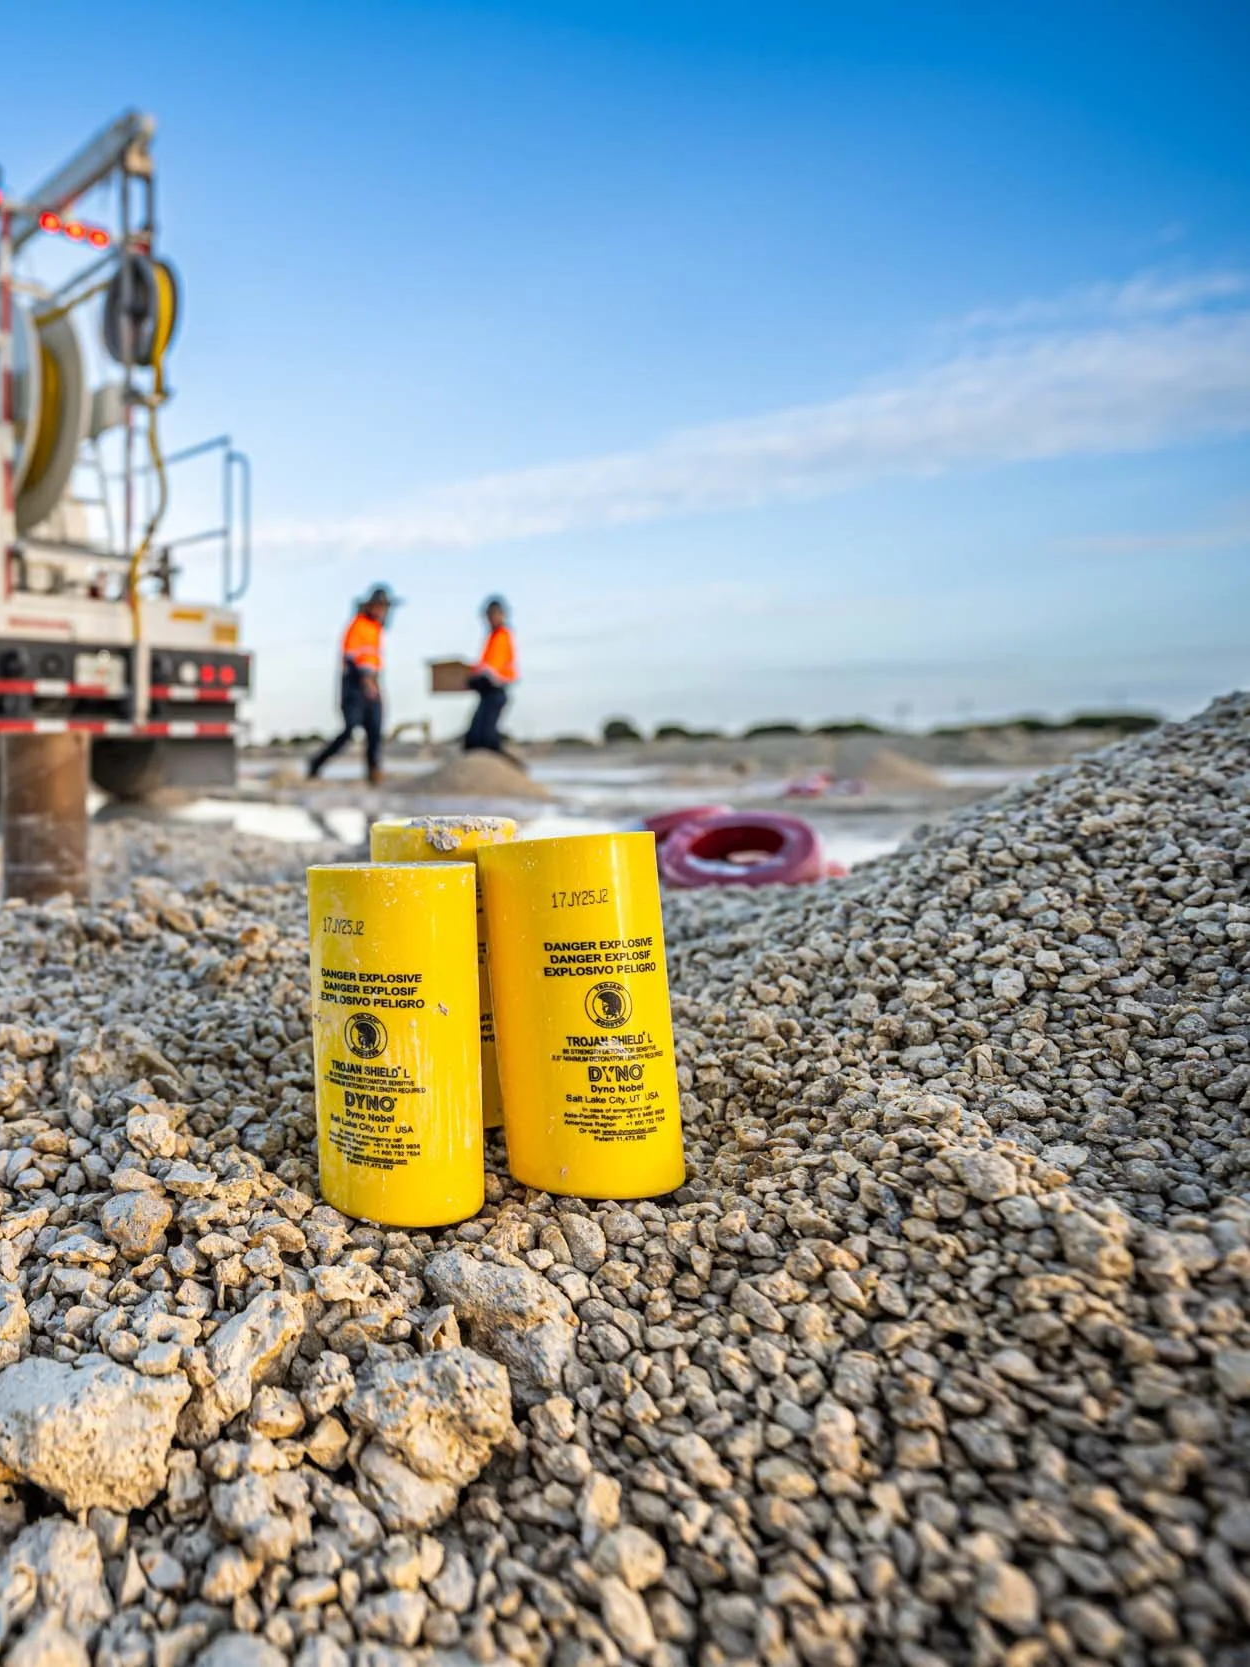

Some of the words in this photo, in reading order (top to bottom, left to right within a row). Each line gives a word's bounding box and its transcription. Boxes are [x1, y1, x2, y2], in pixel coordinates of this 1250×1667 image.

[552, 889, 608, 908] 17JY25J2
[544, 941, 597, 952] DANGER
[600, 937, 653, 950] EXPLOSIVE
[550, 954, 602, 964] DANGER
[605, 950, 651, 962] EXPLOSIF
[321, 967, 356, 981] DANGER
[358, 973, 422, 983] EXPLOSIVE
[544, 965, 614, 976] EXPLOSIVO
[617, 962, 656, 973] PELIGRO
[323, 981, 360, 993] DANGER
[363, 985, 418, 996] EXPLOSIF
[320, 991, 370, 1006] EXPLOSIVO
[373, 998, 425, 1008] PELIGRO
[566, 1035, 608, 1047] TROJAN
[331, 1059, 362, 1074] TROJAN
[588, 1064, 643, 1082] DYNO
[591, 1084, 615, 1094] Dyno
[619, 1082, 644, 1092] Nobel
[344, 1091, 395, 1112] DYNO
[566, 1094, 583, 1103] Salt
[585, 1096, 606, 1104] Lake
[630, 1094, 640, 1103] UT
[645, 1091, 659, 1100] USA
[346, 1108, 365, 1120] Dyno
[368, 1113, 394, 1122] Nobel
[378, 1125, 390, 1133] UT
